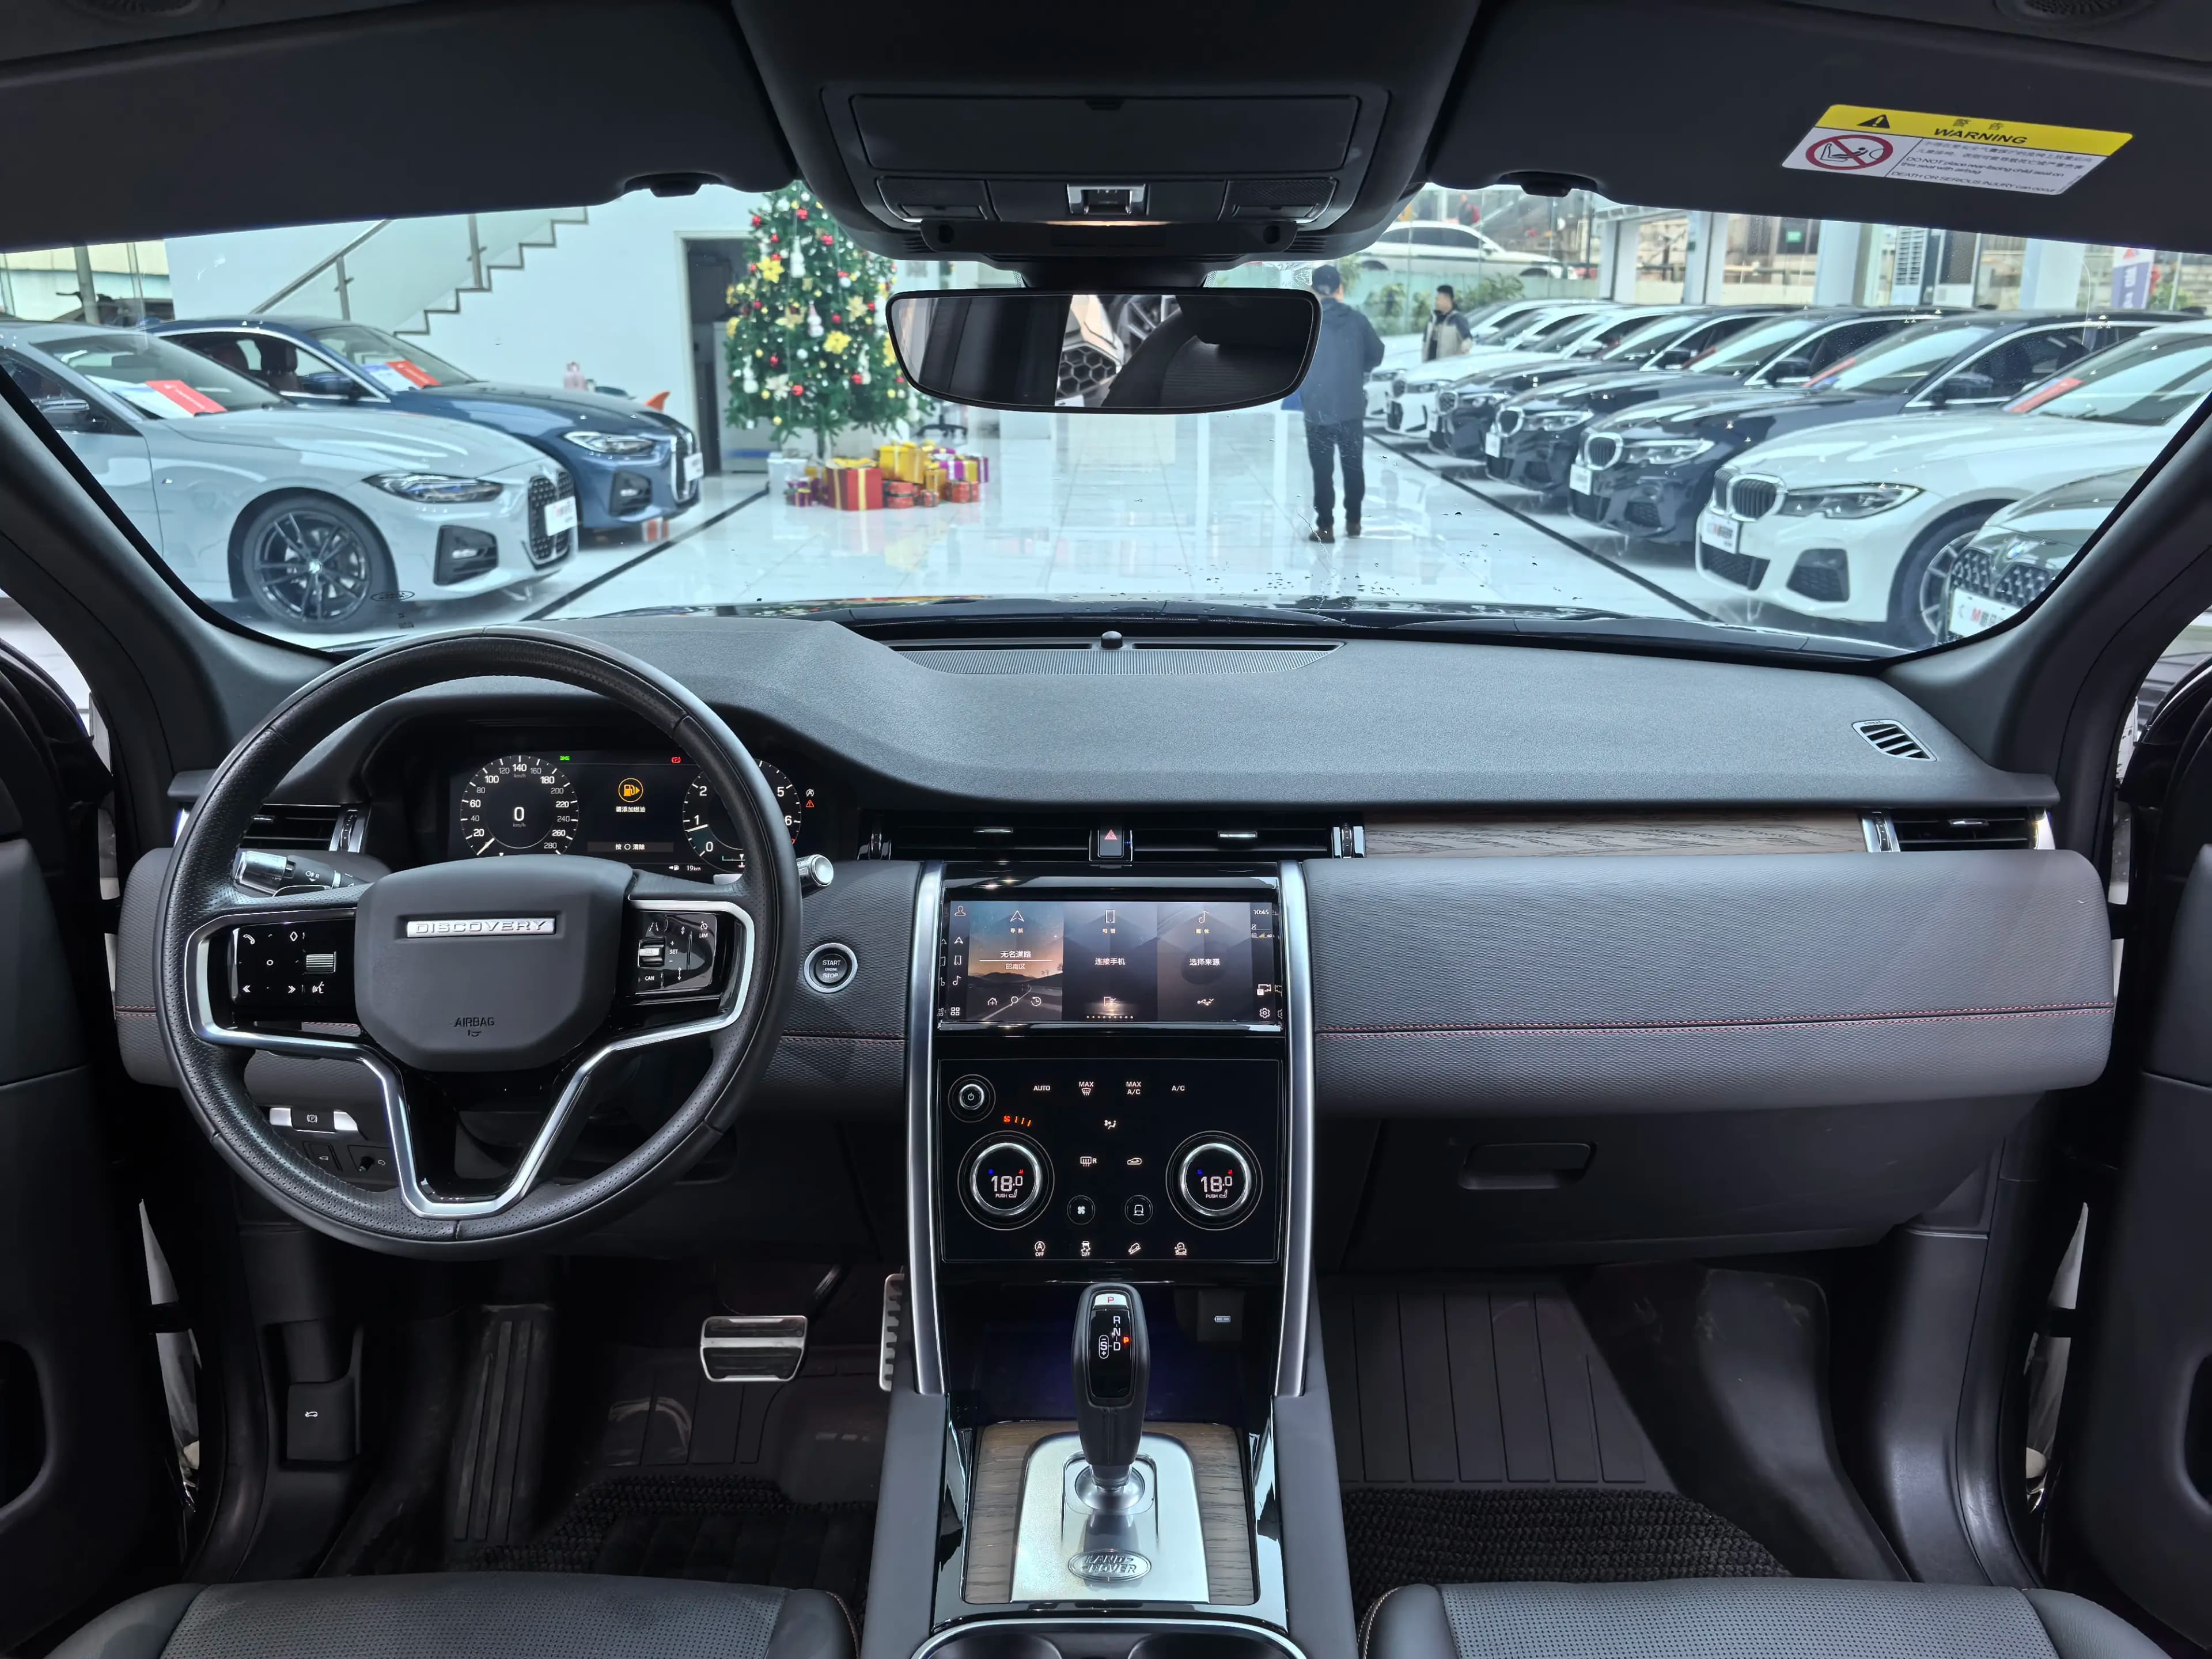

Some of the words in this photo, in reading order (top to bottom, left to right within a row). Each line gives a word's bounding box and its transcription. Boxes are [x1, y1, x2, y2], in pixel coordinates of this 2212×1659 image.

[1934, 128, 2028, 144] WARNING
[512, 764, 527, 772] 140
[484, 775, 499, 783] 100
[540, 776, 555, 784] 180
[699, 786, 707, 796] 2
[777, 786, 785, 797] 5
[470, 800, 481, 808] 60
[514, 806, 524, 821] 0
[694, 815, 699, 825] 1
[785, 815, 792, 825] 6
[706, 842, 714, 852] 0
[416, 921, 547, 934] DISCOVERY
[1094, 957, 1126, 965] 连接手机
[1189, 958, 1221, 966] 选择来源
[454, 1017, 494, 1027] AIRBAG
[991, 1176, 1023, 1192] 18.0
[1200, 1176, 1233, 1192] 18.0
[1113, 1316, 1120, 1324] R
[1113, 1328, 1120, 1336] N
[1100, 1341, 1108, 1350] S
[1113, 1342, 1120, 1351] D
